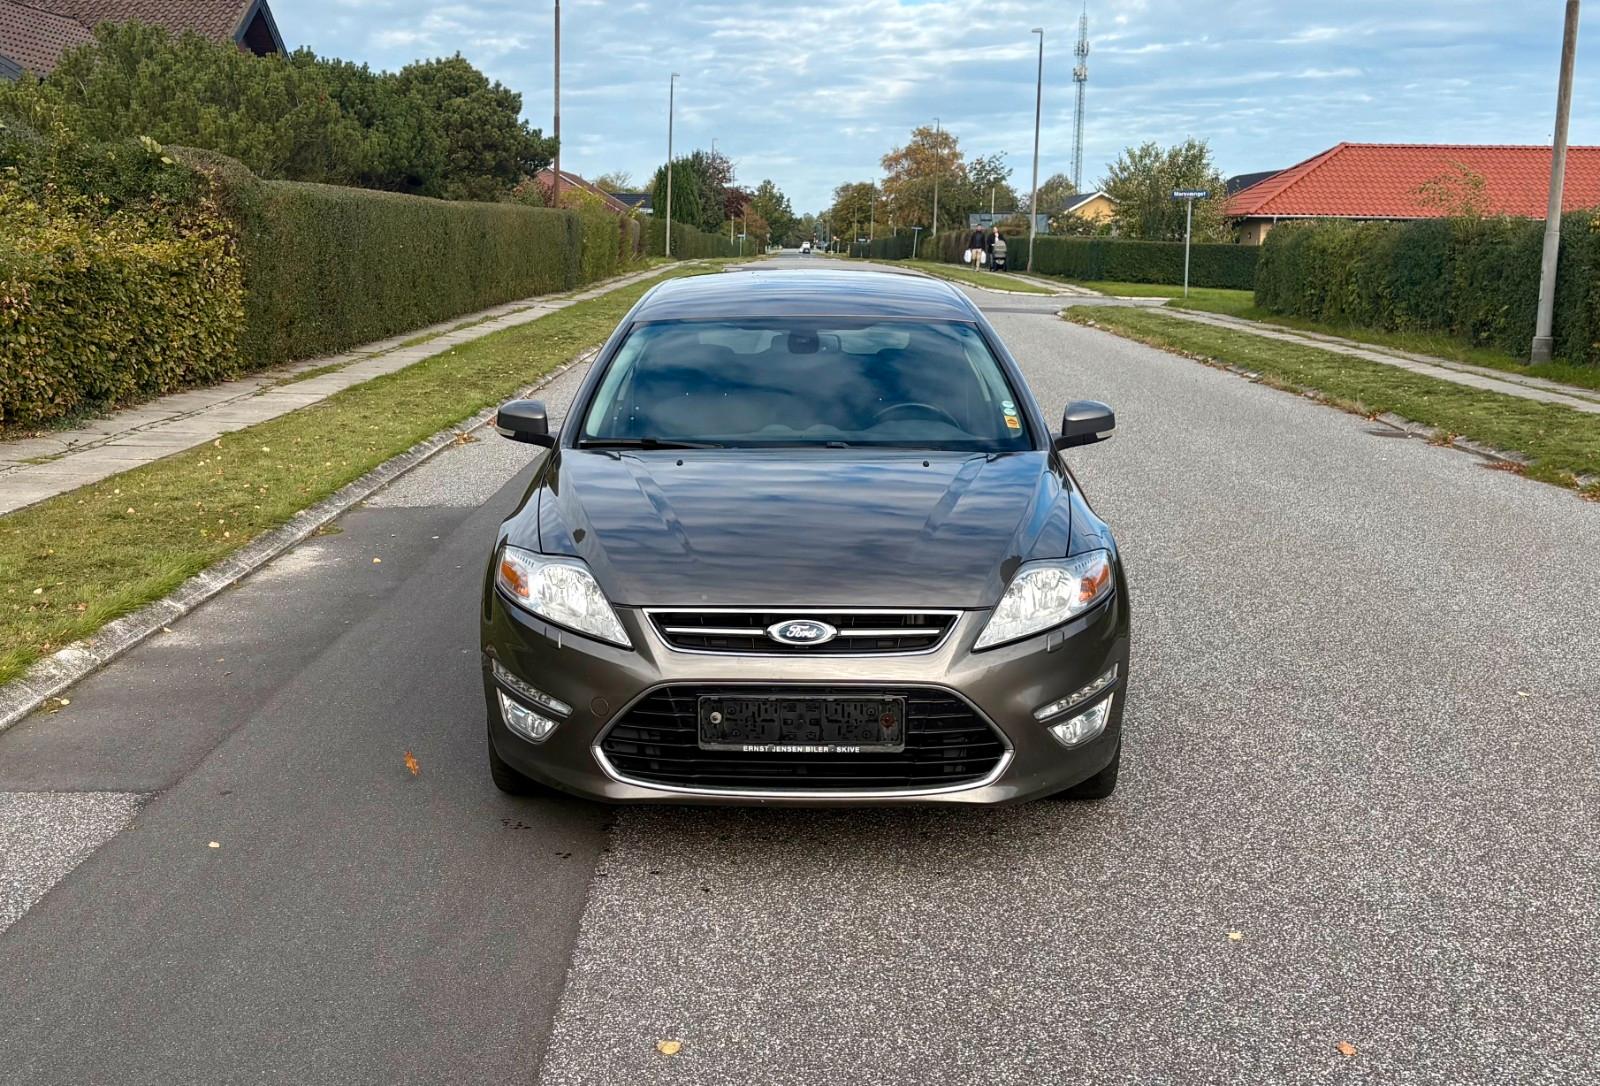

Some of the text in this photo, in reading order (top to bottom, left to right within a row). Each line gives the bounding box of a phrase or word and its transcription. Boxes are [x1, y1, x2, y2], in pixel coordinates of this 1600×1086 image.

[786, 625, 817, 638] Ford
[771, 745, 803, 753] JENSEN
[805, 745, 829, 753] BILER
